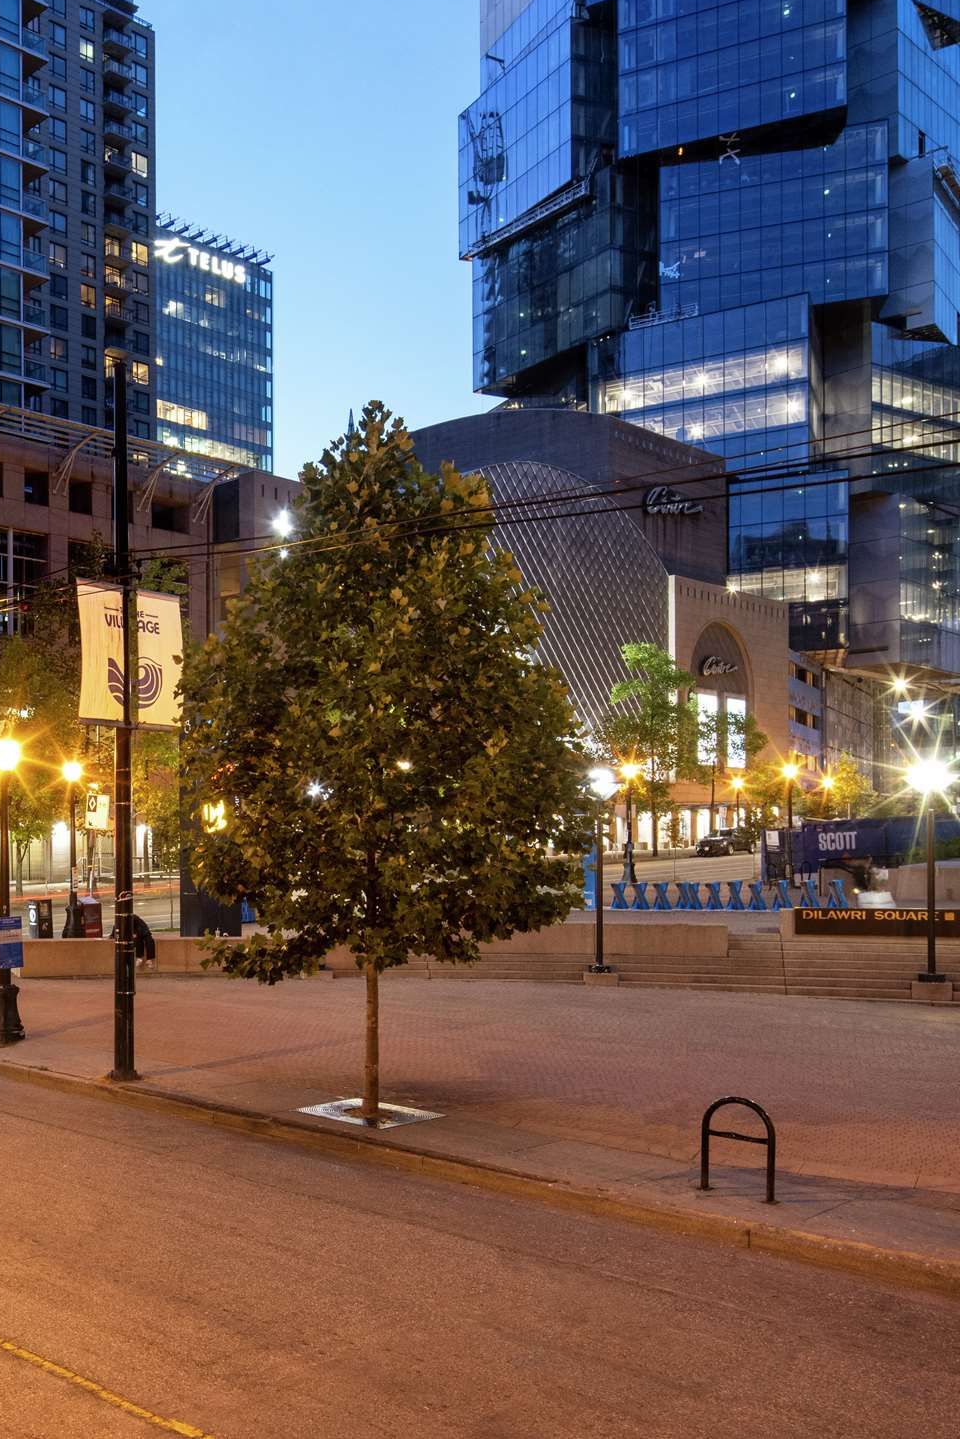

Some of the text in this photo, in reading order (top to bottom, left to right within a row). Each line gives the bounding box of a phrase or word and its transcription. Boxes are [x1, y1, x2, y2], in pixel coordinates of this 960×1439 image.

[188, 247, 246, 284] TELUS
[818, 832, 858, 851] SCOTT
[802, 910, 866, 921] DILAWRI
